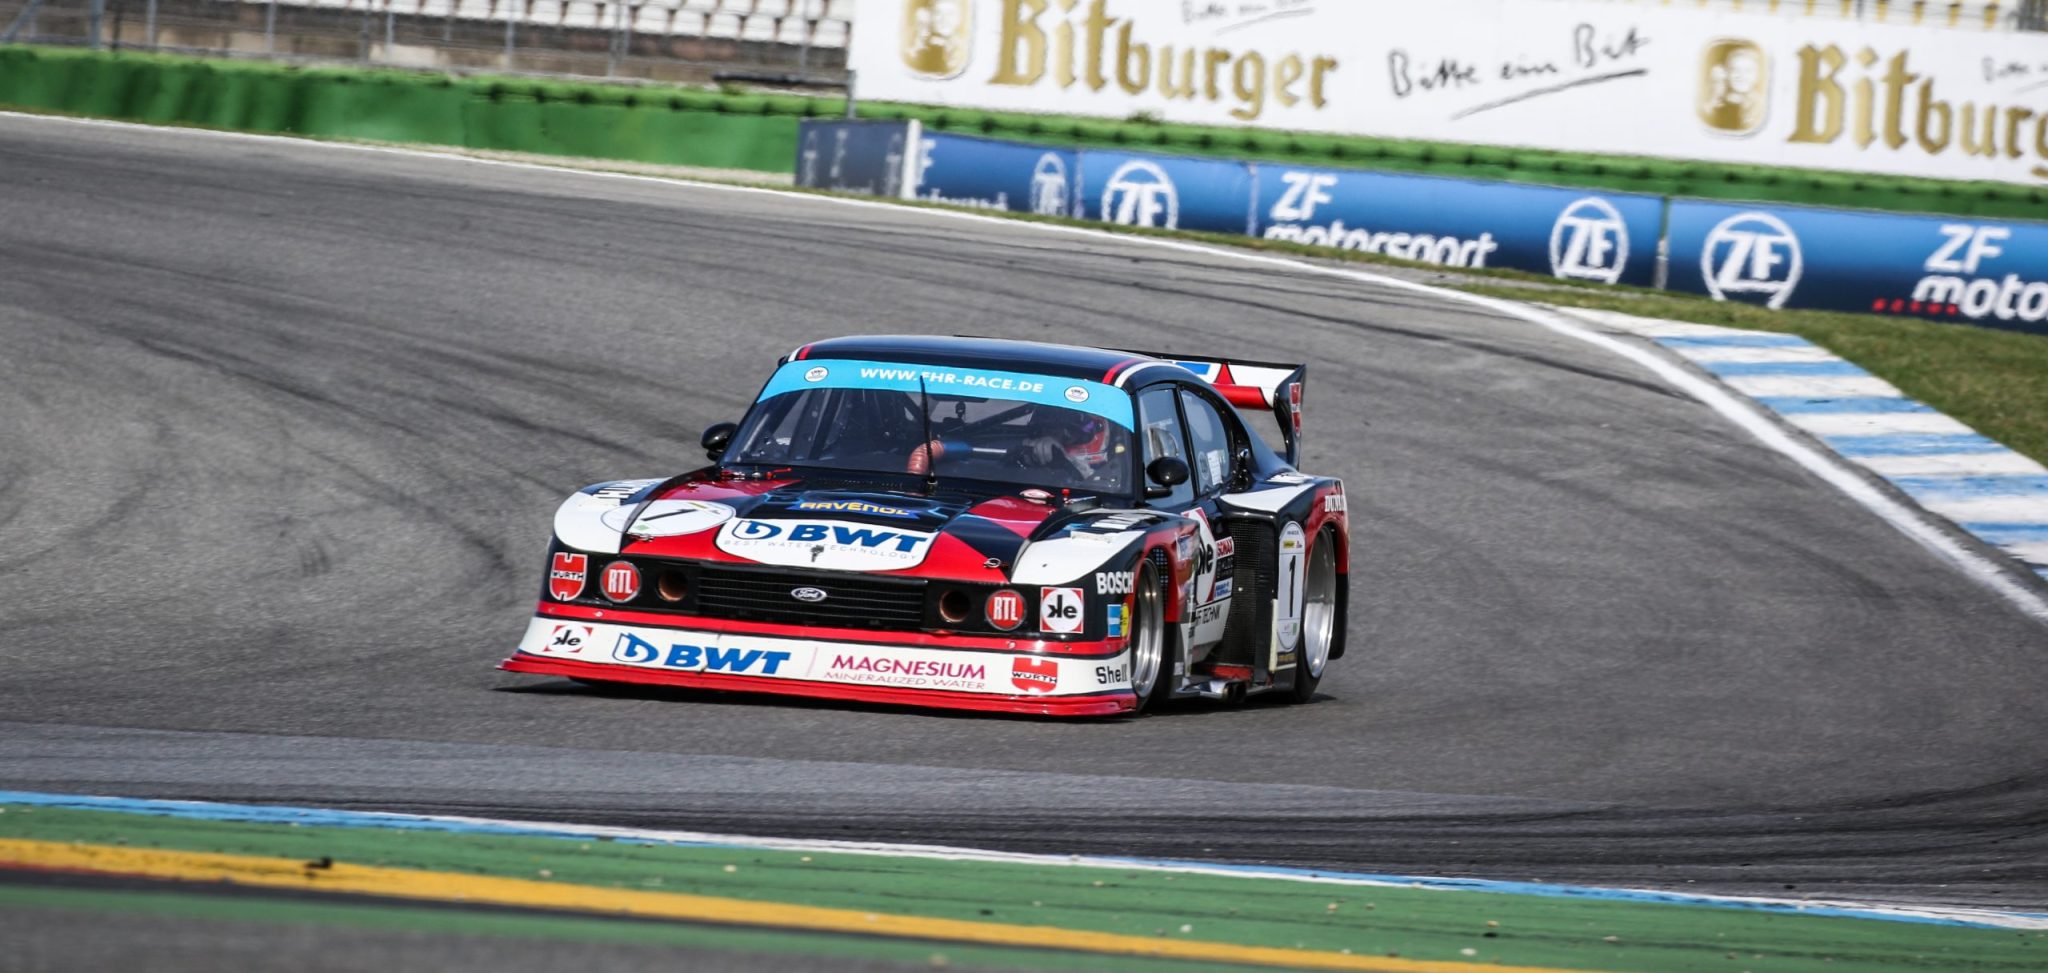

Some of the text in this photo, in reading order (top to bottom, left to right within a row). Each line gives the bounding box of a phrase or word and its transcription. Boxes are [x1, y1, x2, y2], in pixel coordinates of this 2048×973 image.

[988, 0, 1338, 121] Bitburger
[1388, 50, 1477, 97] Bitte
[1269, 172, 1338, 221] ZF
[1924, 223, 2011, 274] ZF
[860, 368, 1044, 393] WWW.FHR-RACE.DE
[787, 524, 927, 553] BWT
[608, 569, 633, 593] RTL
[1096, 572, 1134, 595] BOSCH
[1289, 554, 1297, 618] 1
[993, 596, 1018, 620] RTL
[664, 644, 791, 674] BWT
[831, 654, 985, 680] MAGNESIUM
[824, 672, 985, 690] MINERALIZED WATER
[1096, 664, 1127, 684] Shell
